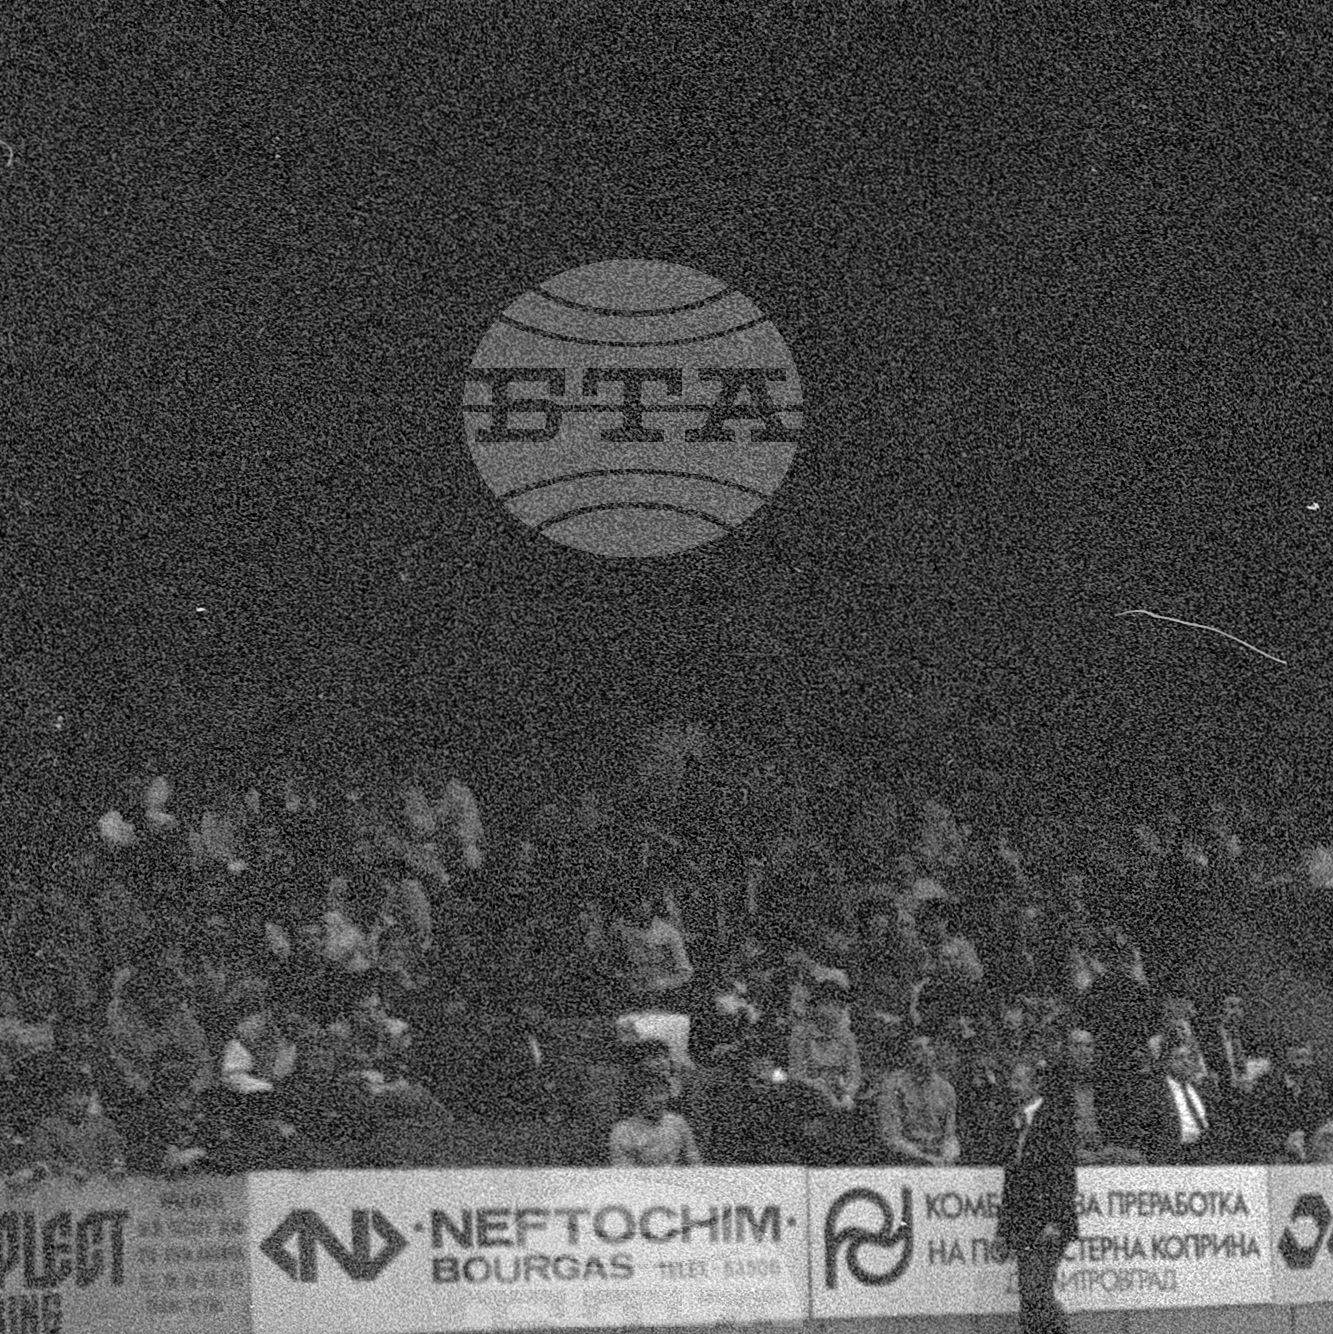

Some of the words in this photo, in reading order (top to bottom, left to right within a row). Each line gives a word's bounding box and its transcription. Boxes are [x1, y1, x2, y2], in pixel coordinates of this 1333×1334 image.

[925, 1191, 1001, 1220] КОМБ
[1107, 1190, 1250, 1217] ПРЕРАБОТКА
[430, 1205, 783, 1250] NEFTOCHIM
[928, 1238, 966, 1266] НА
[1150, 1234, 1260, 1260] КОПРИНА
[431, 1253, 637, 1284] BOURGAS
